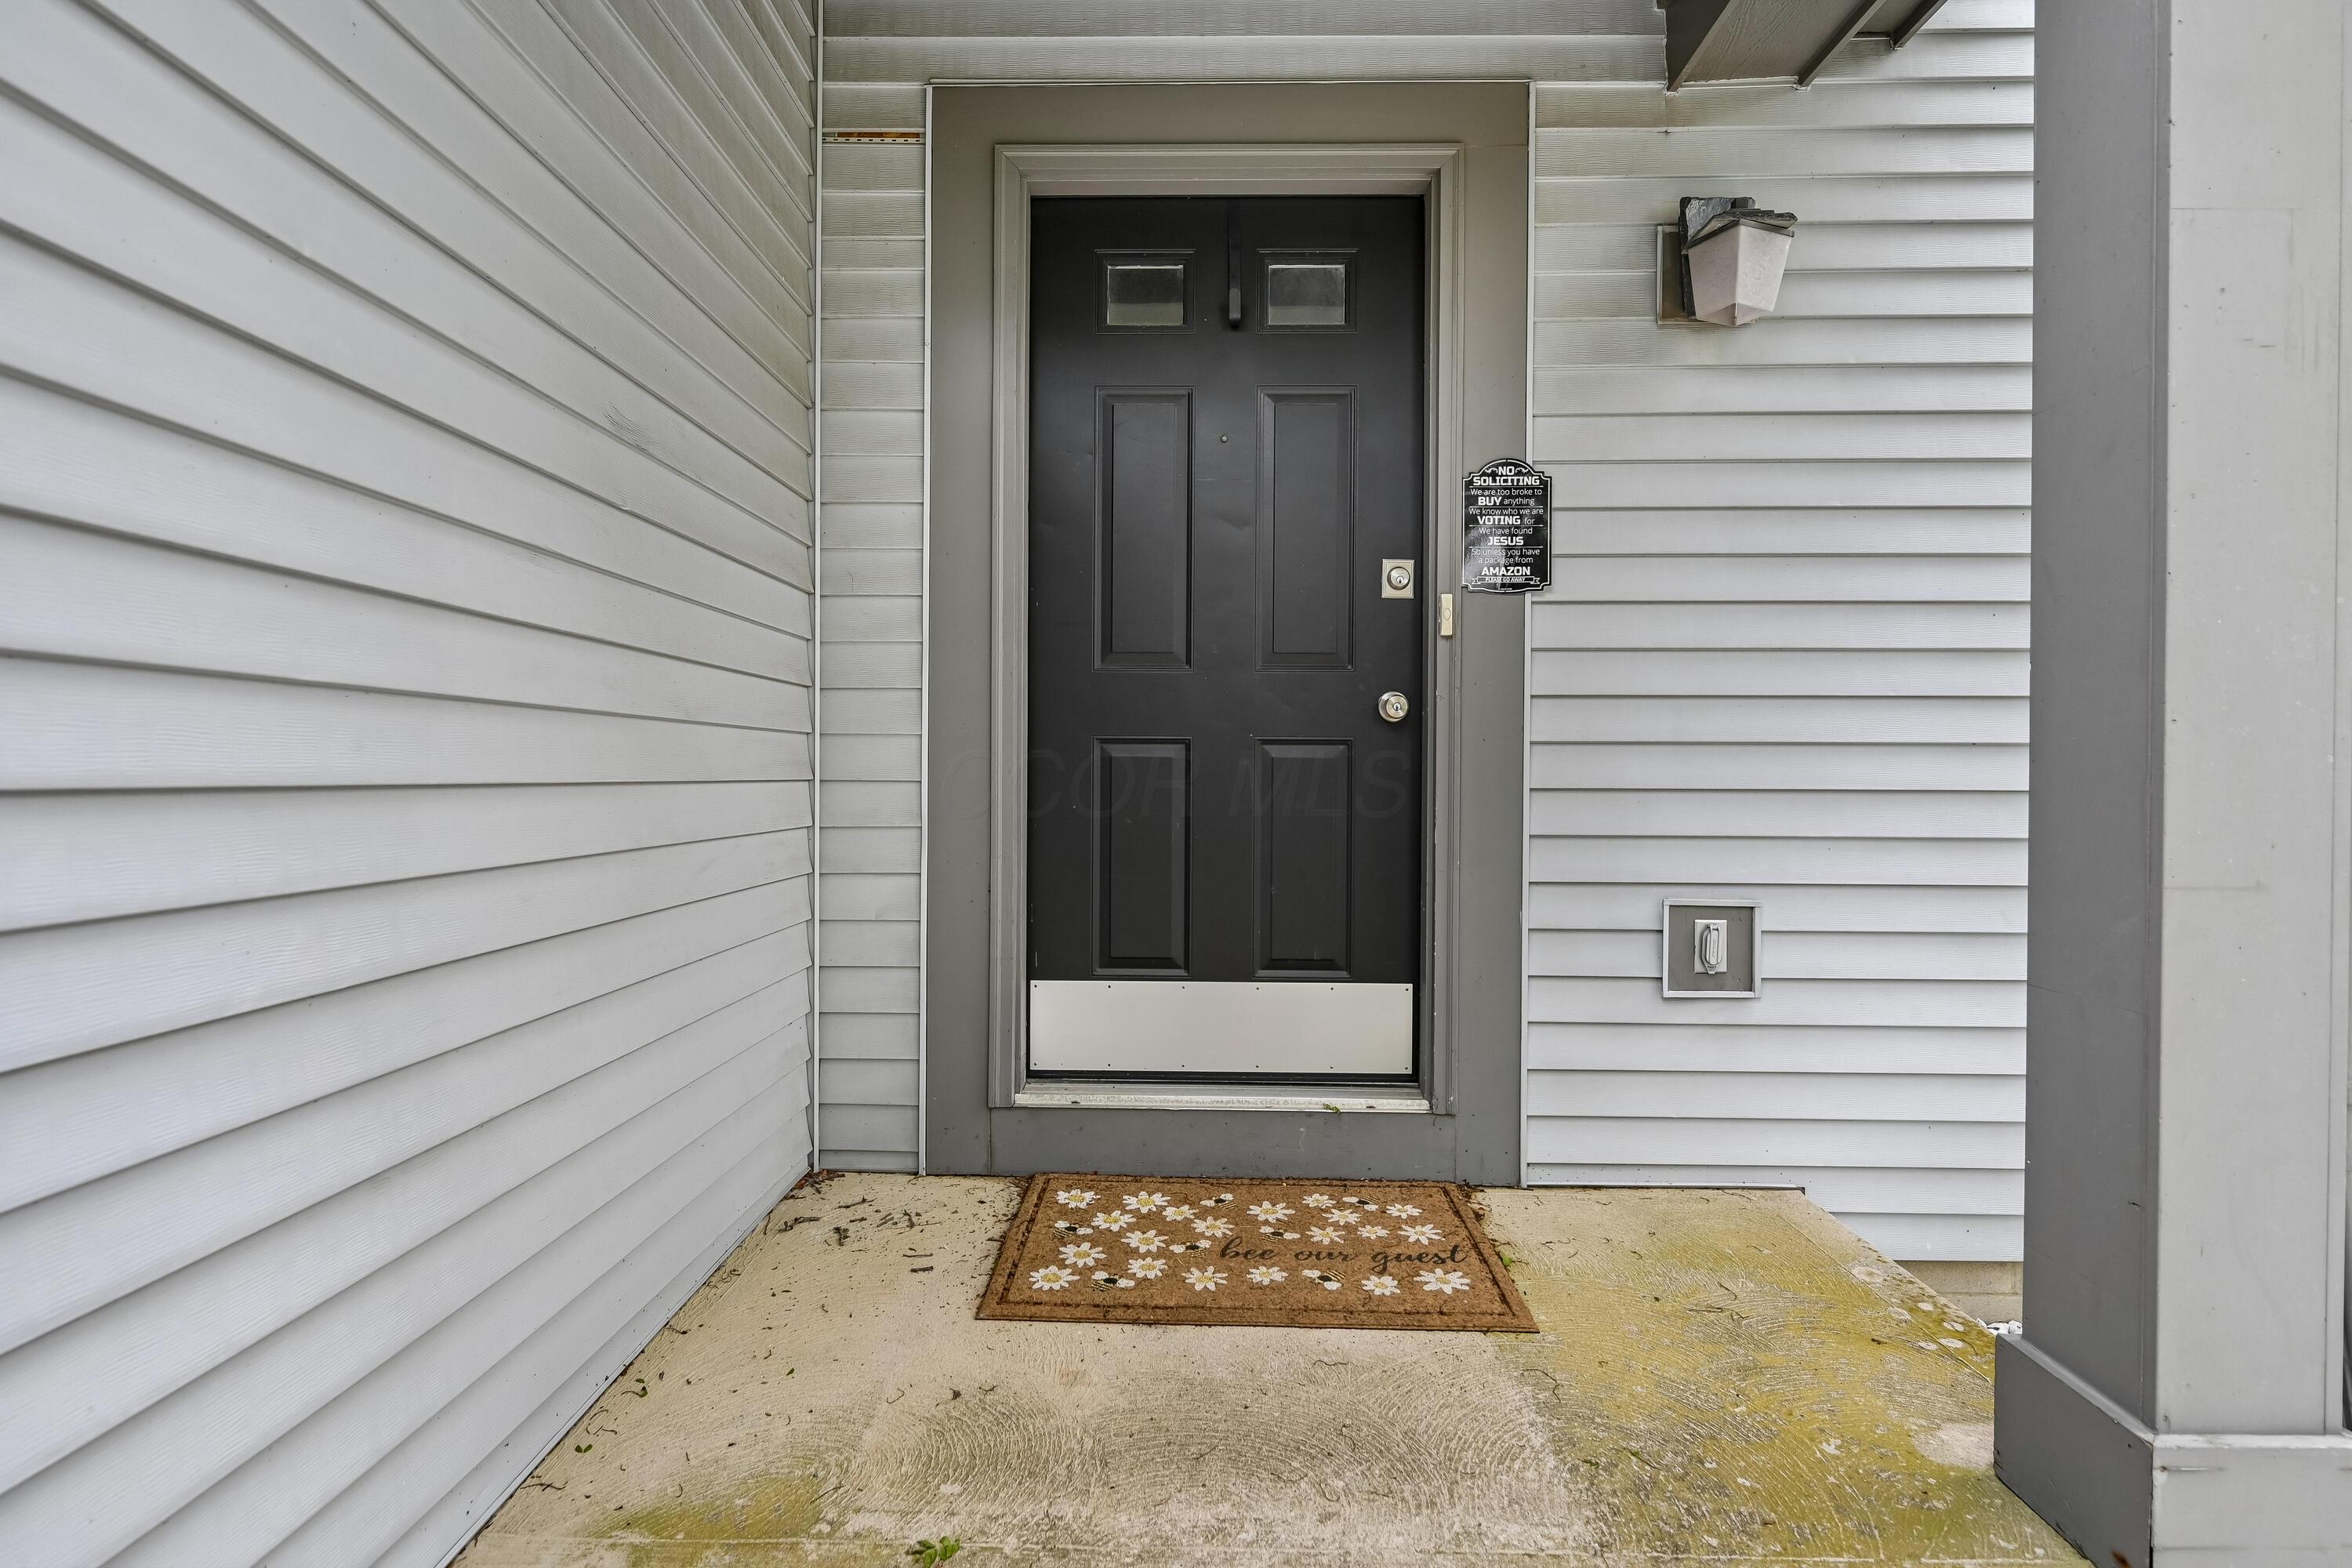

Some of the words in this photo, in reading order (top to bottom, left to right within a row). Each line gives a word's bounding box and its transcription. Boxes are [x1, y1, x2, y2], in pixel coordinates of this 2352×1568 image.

[1498, 466, 1515, 475] NO
[1473, 476, 1540, 485] SOLICITING
[1478, 496, 1502, 506] BUY
[1504, 497, 1535, 506] anything
[1477, 516, 1521, 524] VOTING
[1488, 536, 1524, 546] JESUS
[1484, 557, 1514, 565] package
[1481, 566, 1530, 575] AMAZON
[1219, 1236, 1279, 1261] bee
[1294, 1250, 1359, 1263] our
[1371, 1244, 1468, 1274] guest
